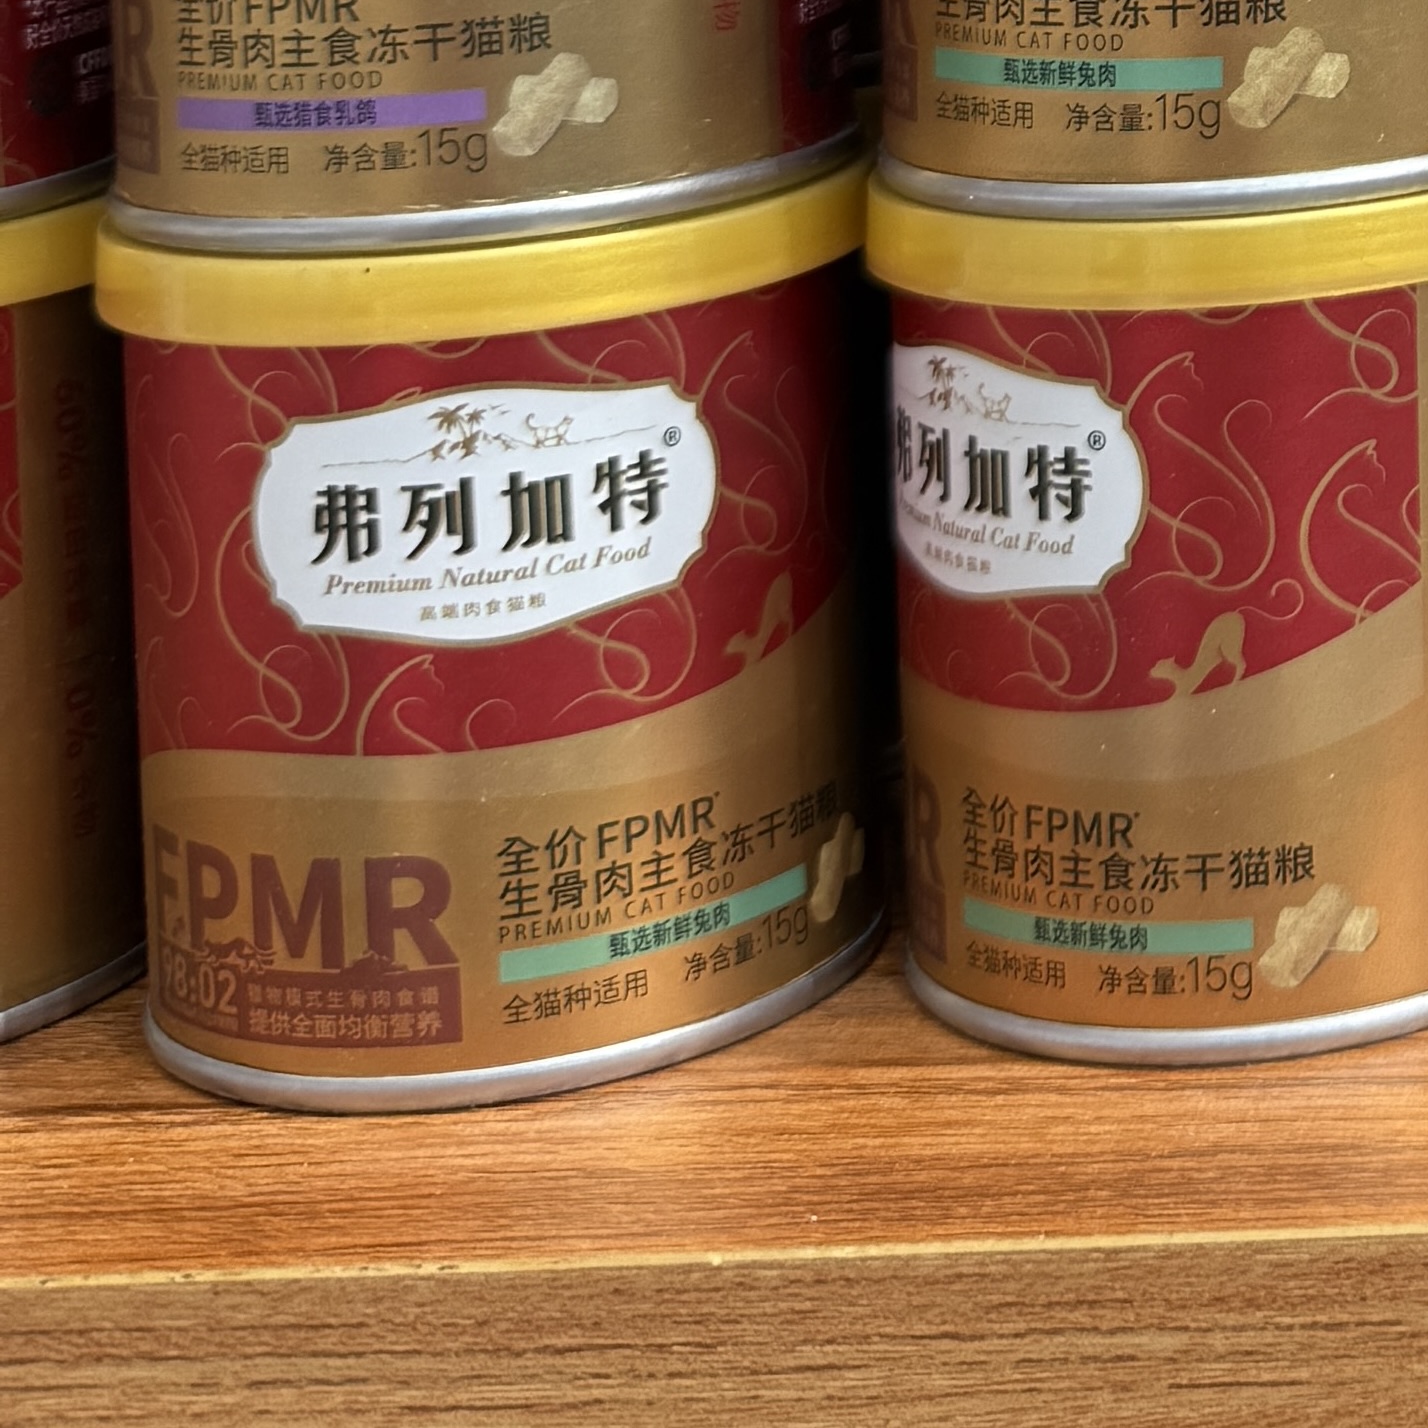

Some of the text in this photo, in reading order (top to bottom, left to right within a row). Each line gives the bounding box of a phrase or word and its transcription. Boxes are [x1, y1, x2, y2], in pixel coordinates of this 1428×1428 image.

[177, 11, 552, 70] 生骨肉主食冻干猫粮
[1004, 58, 1117, 88] 甄选新鲜兔肉
[935, 92, 1221, 138] 全猫种适用 净含量:15g
[312, 448, 671, 567] 弗列加特
[498, 796, 715, 877] 全价FPMR
[961, 785, 1134, 849] 全价FPMR
[498, 781, 839, 922] 生骨肉主食冻干猫粮
[963, 827, 1315, 895] 生骨肉主食冻干猫粮
[153, 823, 461, 972] FPMR
[609, 903, 731, 960] 甄选新鲜兔肉
[1034, 917, 1149, 951] 甄选新鲜兔肉
[503, 904, 810, 1026] 全猫种适用 净含量:15g
[965, 940, 1255, 1000] 全猫种适用 净含量:15g
